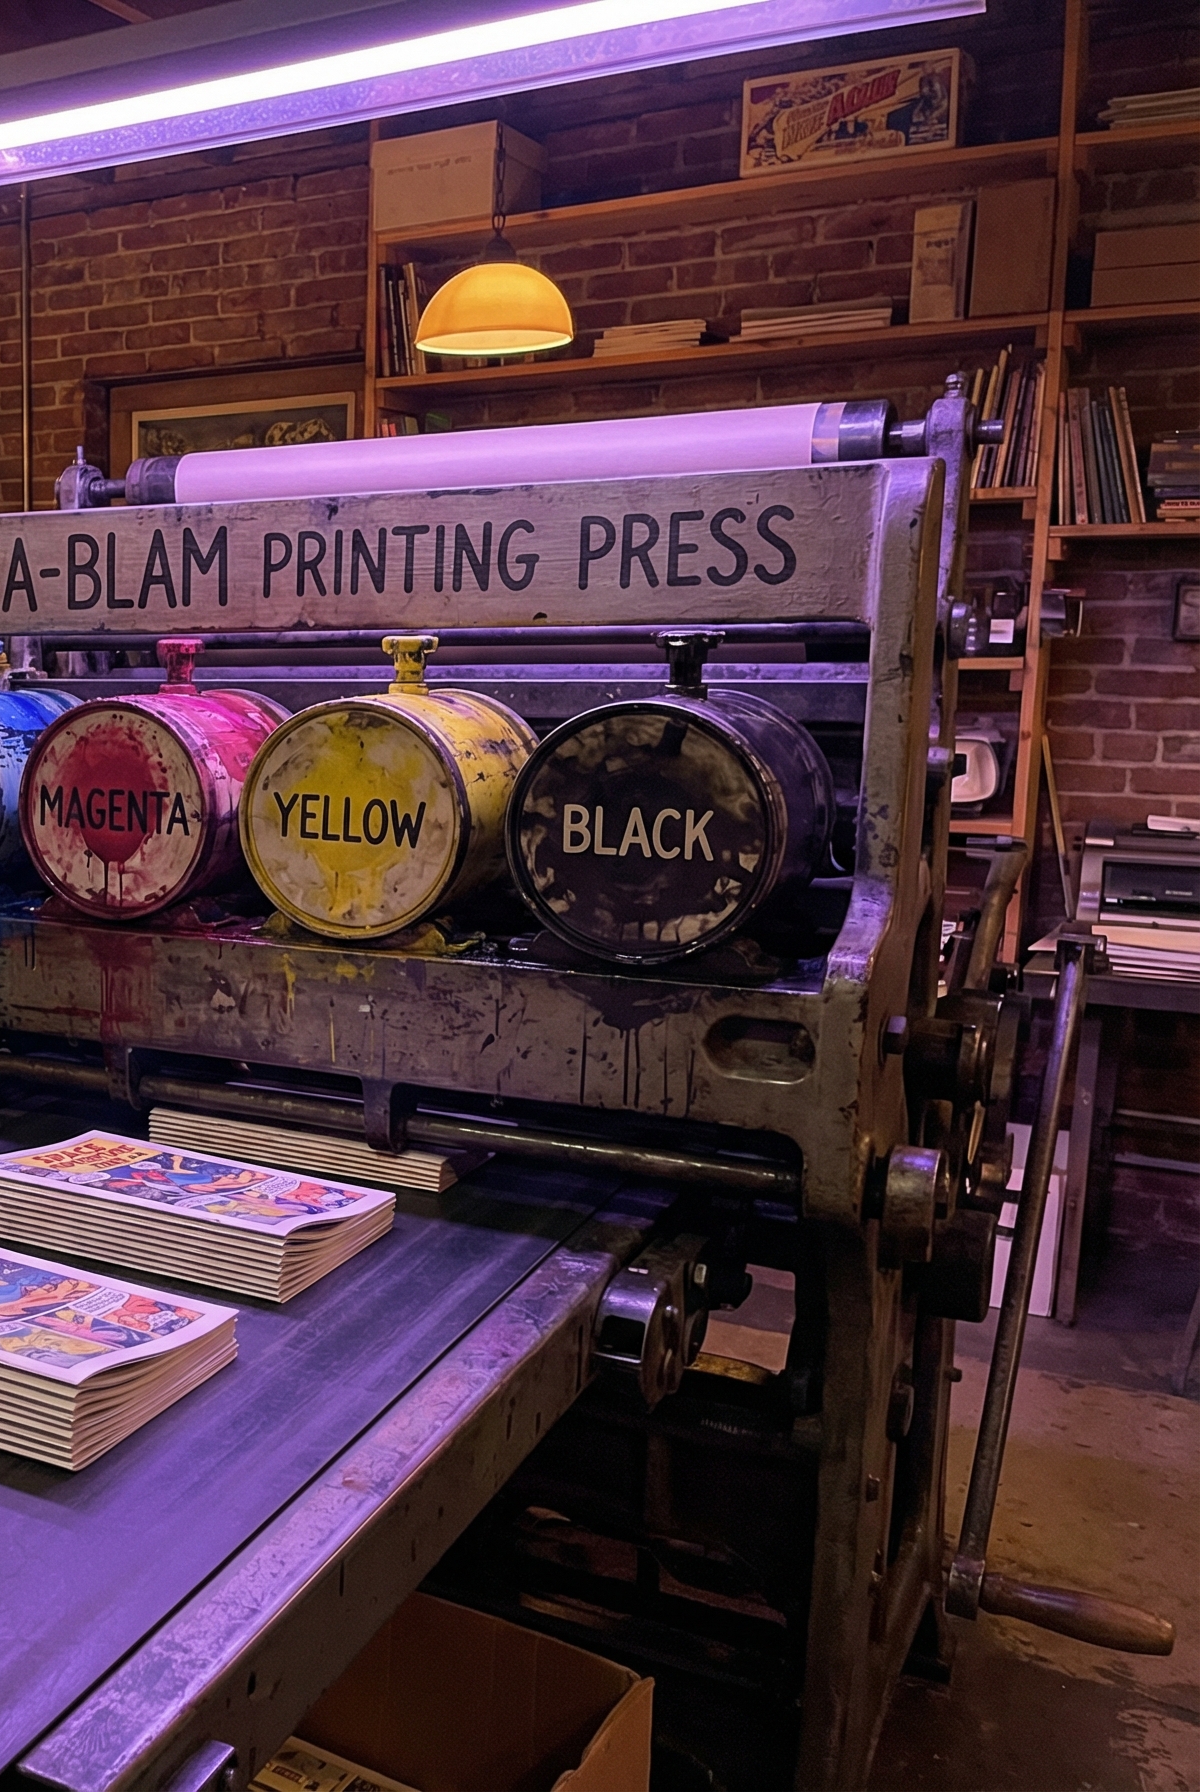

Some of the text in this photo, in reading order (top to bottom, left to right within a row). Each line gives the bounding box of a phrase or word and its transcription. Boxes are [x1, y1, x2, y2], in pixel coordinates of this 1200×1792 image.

[263, 519, 541, 599] PRINTING
[578, 504, 798, 591] PRESS
[40, 784, 191, 837] MAGENTA
[273, 791, 427, 850] YELLOW
[563, 803, 715, 862] BLACK
